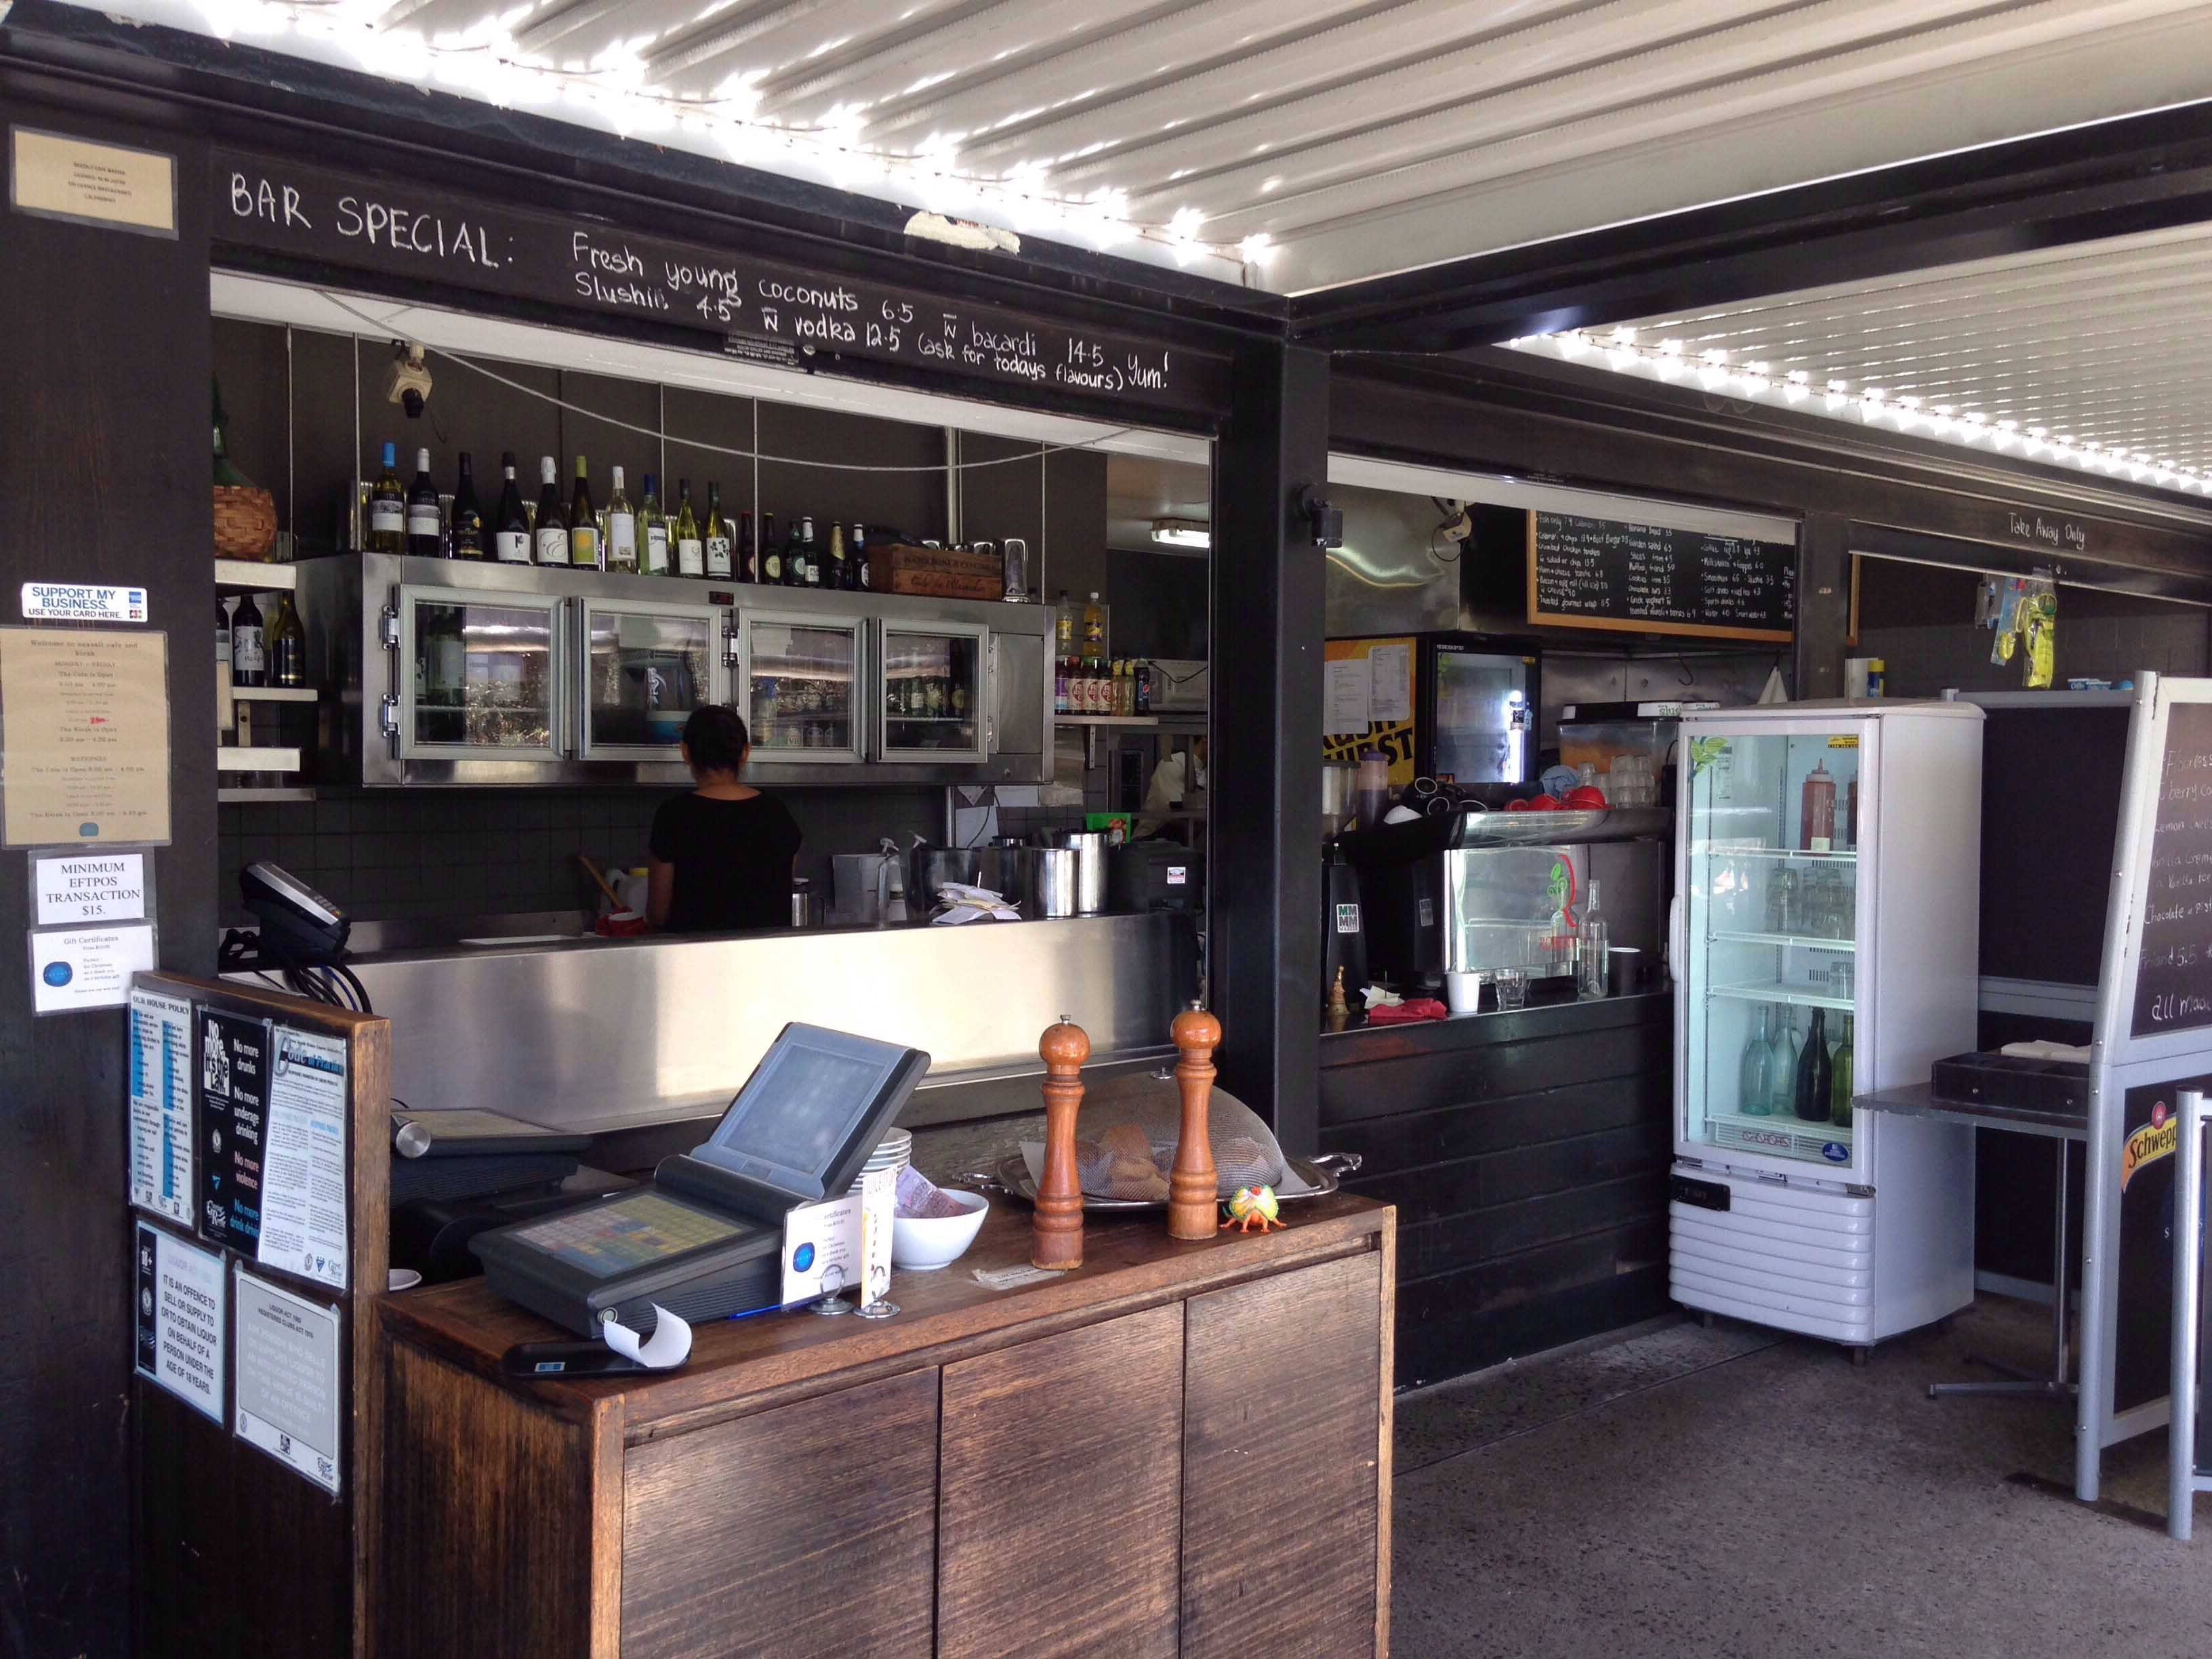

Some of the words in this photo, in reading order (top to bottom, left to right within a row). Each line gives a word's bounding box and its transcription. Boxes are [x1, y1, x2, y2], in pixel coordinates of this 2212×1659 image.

[232, 171, 312, 229] BAR
[573, 231, 643, 276] Fresh
[665, 261, 743, 308] young
[758, 278, 859, 312] coconuts
[971, 321, 1036, 356] bacardi
[1128, 352, 1170, 389] Yum!
[794, 312, 856, 342] vodka
[918, 332, 956, 360] (ask
[962, 343, 985, 366] for
[994, 354, 1046, 380] todays
[1055, 363, 1124, 391] flavours)
[2008, 512, 2030, 537] Take
[2036, 517, 2059, 545] Away
[2065, 524, 2085, 551] Only
[32, 586, 94, 600] SUPPORT
[96, 589, 117, 600] MY
[41, 597, 110, 610] BUSINESS.
[28, 608, 46, 616] USE
[47, 609, 71, 617] YOUR
[73, 610, 97, 618] CARD
[61, 862, 125, 874] MINIMUM
[69, 876, 119, 888] EFTPOS
[45, 889, 142, 903] TRANSACTION
[64, 937, 77, 945] Gift
[79, 936, 119, 944] Certificates
[133, 996, 146, 1004] OUR
[146, 998, 167, 1010] HOUSE
[168, 1002, 190, 1015] POLICY
[2152, 992, 2174, 1021] all
[233, 1038, 243, 1053] No
[243, 1044, 260, 1058] more
[237, 1057, 256, 1076] drunks
[234, 1085, 244, 1101] No
[243, 1092, 260, 1107] more
[234, 1105, 260, 1127] underage
[236, 1122, 259, 1146] drinking
[234, 1150, 244, 1166] No
[243, 1158, 260, 1172] more
[235, 1170, 258, 1190] violence
[234, 1197, 244, 1214] No
[243, 1205, 260, 1221] more
[163, 1273, 169, 1285] IT
[169, 1277, 174, 1288] IS
[175, 1280, 183, 1293] AN
[183, 1284, 208, 1307] OFFENCE
[208, 1297, 216, 1311] TO
[164, 1290, 177, 1307] SELL
[178, 1298, 186, 1311] OR
[186, 1303, 207, 1322] SUPPLY
[207, 1313, 215, 1327] TO
[161, 1306, 169, 1319] OR
[169, 1309, 176, 1323] TO
[177, 1315, 197, 1334] OBTAIN
[197, 1326, 217, 1347] LIQUOR
[167, 1326, 176, 1339] ON
[176, 1331, 197, 1351] BEHALF
[197, 1343, 205, 1355] OF
[205, 1349, 210, 1360] A
[163, 1340, 185, 1361] PERSON
[185, 1353, 203, 1373] UNDER
[203, 1364, 214, 1380] THE
[166, 1359, 177, 1374] AGE
[178, 1366, 185, 1378] OF
[186, 1372, 192, 1383] 18
